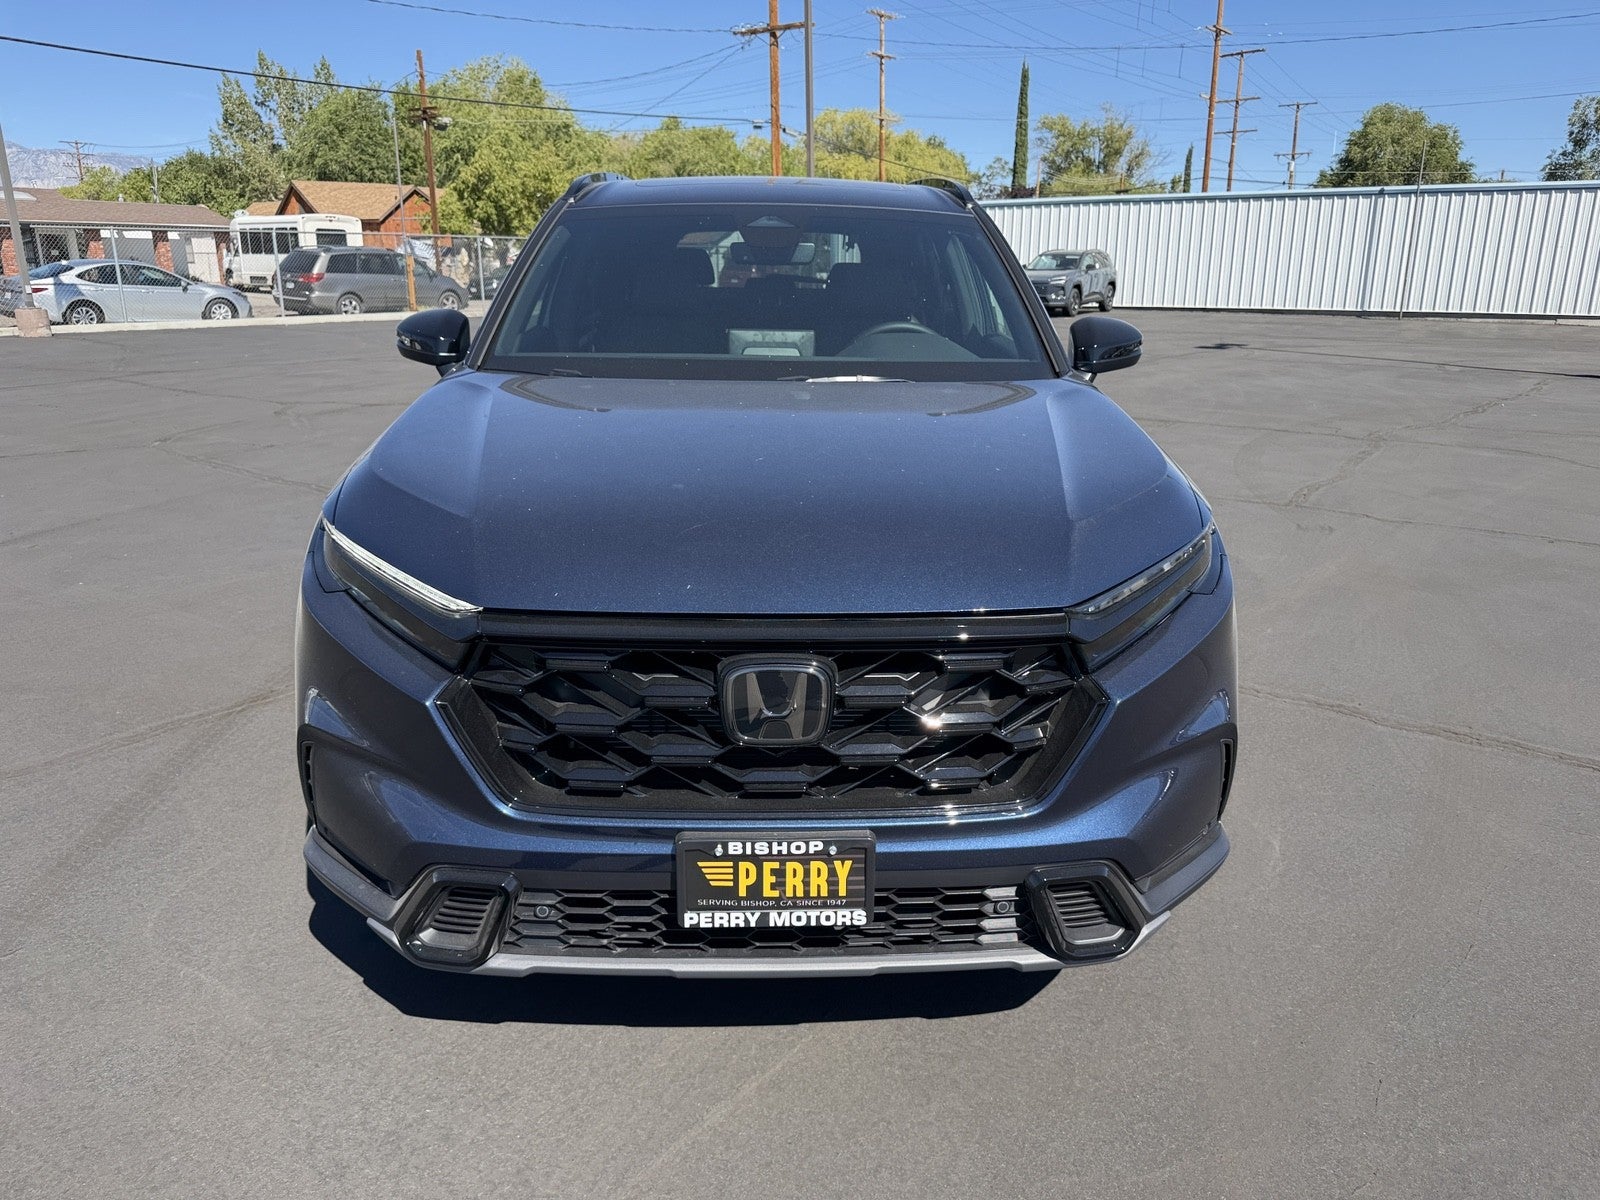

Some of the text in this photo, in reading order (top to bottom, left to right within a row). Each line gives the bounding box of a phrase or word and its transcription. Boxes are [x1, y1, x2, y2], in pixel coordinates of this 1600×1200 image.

[728, 841, 824, 855] BISHOP
[738, 860, 853, 897] PERRY
[683, 910, 867, 928] PERRY MOTORS
